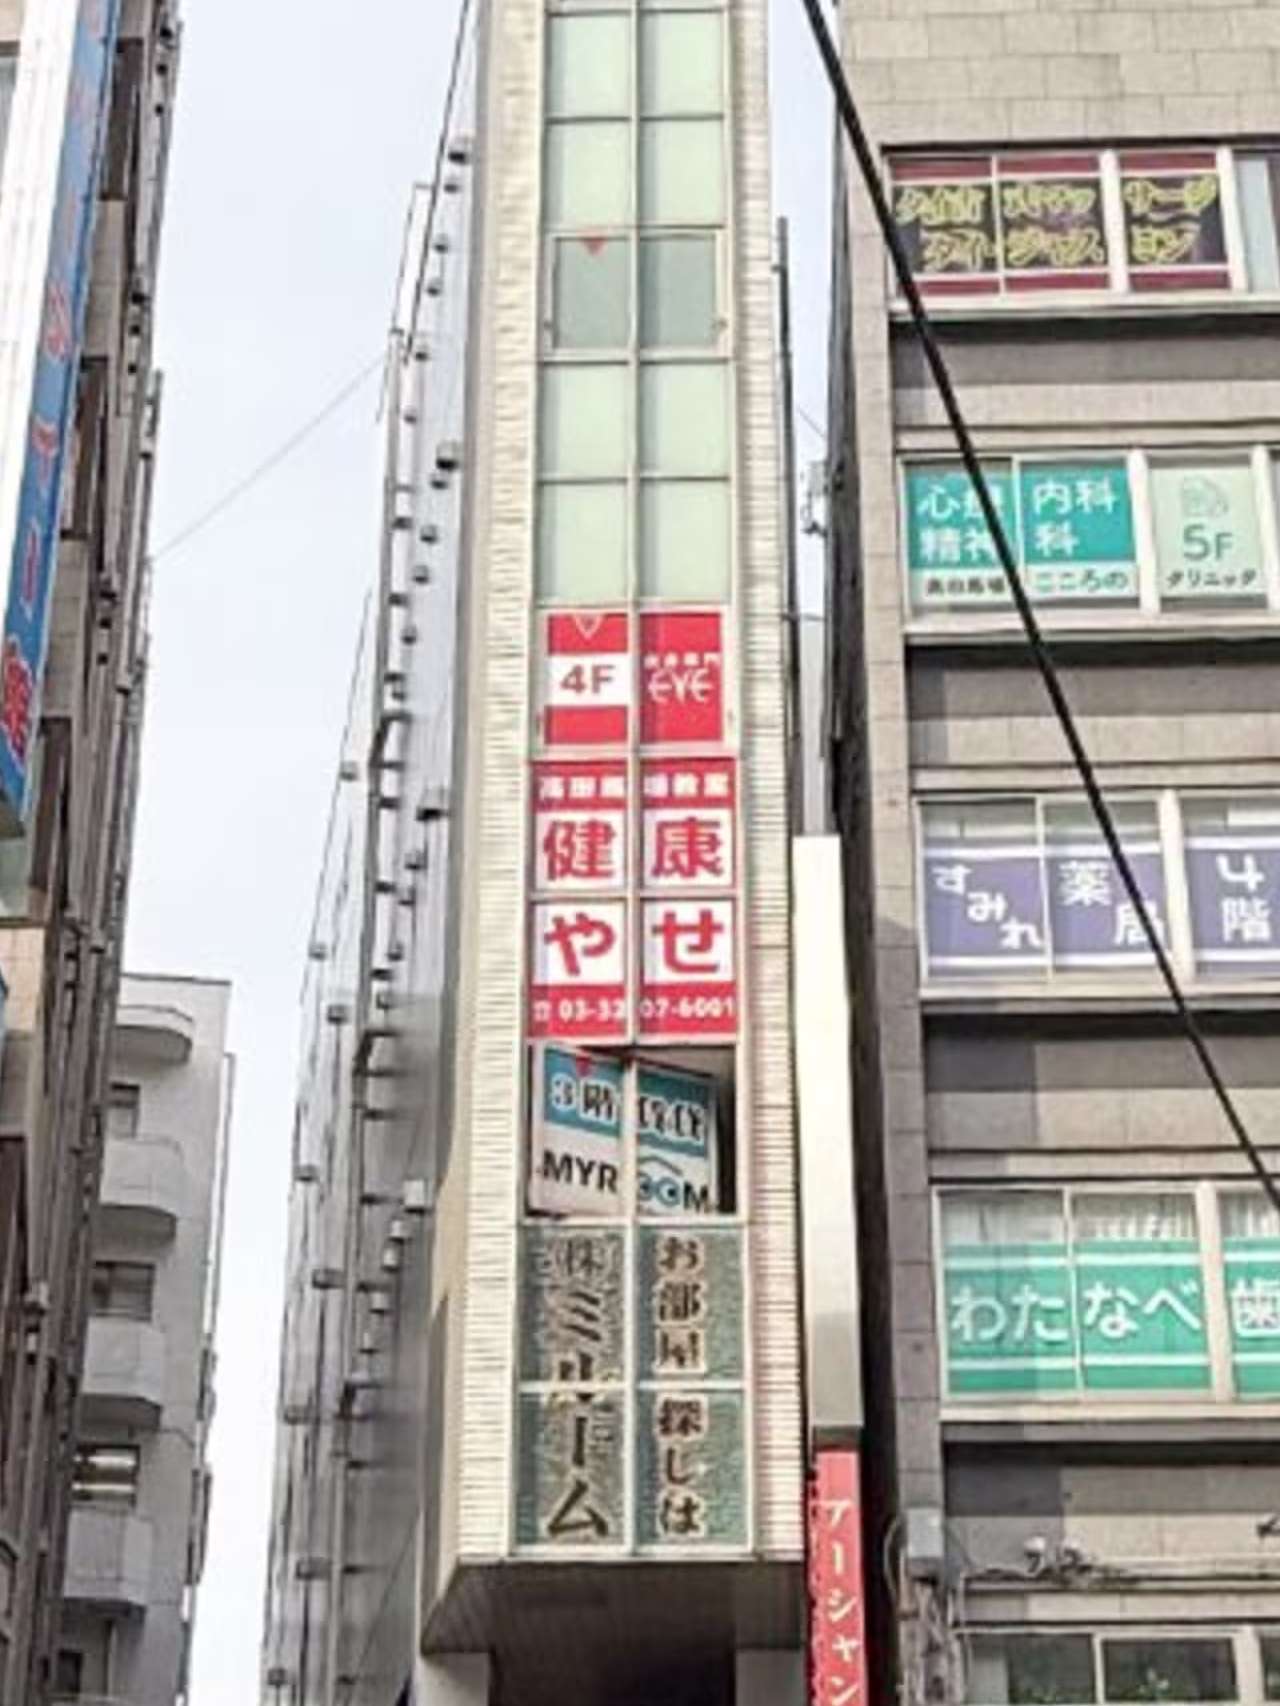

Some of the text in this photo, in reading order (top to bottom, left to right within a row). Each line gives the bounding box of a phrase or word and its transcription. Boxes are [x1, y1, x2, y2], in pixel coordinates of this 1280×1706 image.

[1182, 523, 1235, 561] 5F
[1035, 572, 1130, 592] こころの
[1167, 569, 1258, 589] クリニック
[560, 664, 616, 695] 4F
[542, 818, 724, 880] 健康
[1216, 854, 1272, 943] 4階
[544, 907, 724, 976] やせ
[657, 1233, 707, 1539] お部屋探しは
